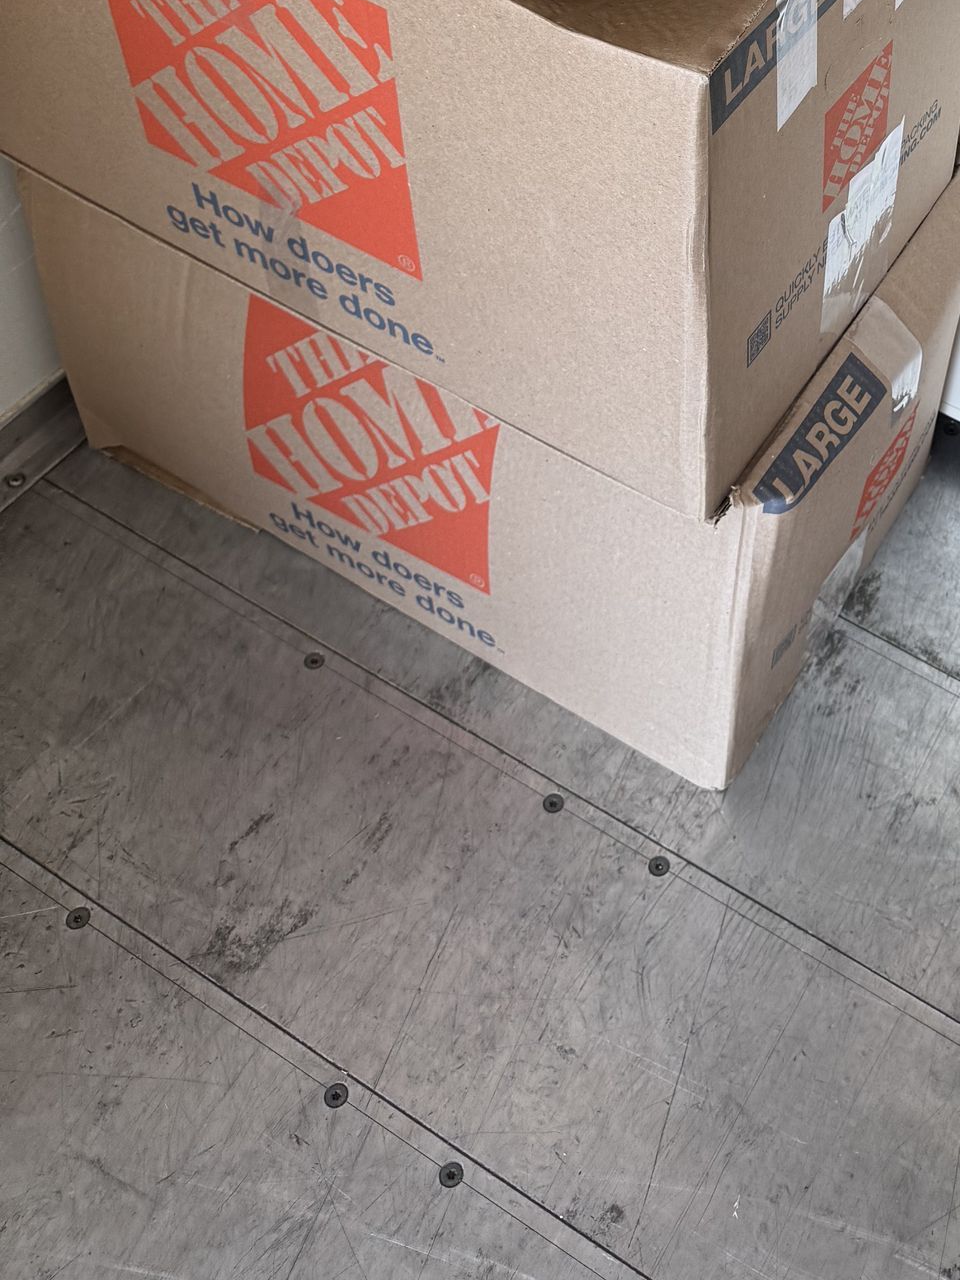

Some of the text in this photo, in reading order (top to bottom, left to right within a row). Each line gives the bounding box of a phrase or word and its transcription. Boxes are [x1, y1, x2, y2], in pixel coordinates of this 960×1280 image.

[247, 106, 406, 217] DEPOT
[167, 202, 225, 250] get
[234, 238, 328, 301] more
[191, 183, 395, 306] How doers
[775, 246, 821, 313] QUICKLY
[775, 268, 815, 329] SUPPLY
[772, 375, 872, 505] LARGE
[341, 451, 491, 536] DEPOT
[269, 512, 319, 549] get
[327, 545, 406, 598] more
[290, 502, 465, 610] How doers
